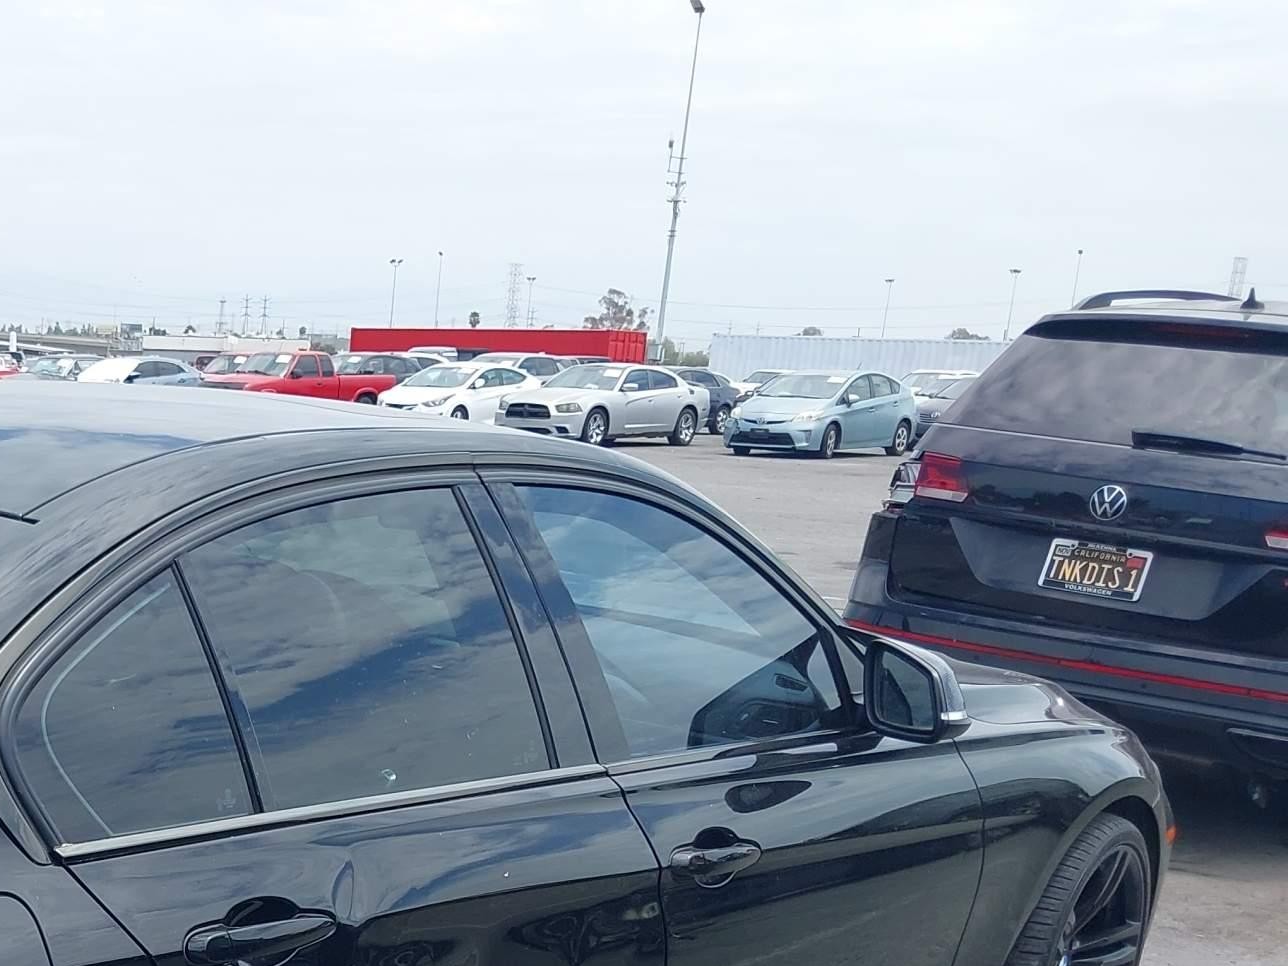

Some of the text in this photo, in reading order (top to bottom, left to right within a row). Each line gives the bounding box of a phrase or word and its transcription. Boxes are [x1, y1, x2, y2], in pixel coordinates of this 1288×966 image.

[1074, 549, 1126, 562] CALIFORNIA
[1049, 556, 1122, 588] TNKDIS
[1064, 583, 1112, 595] VOLKSWAGEN
